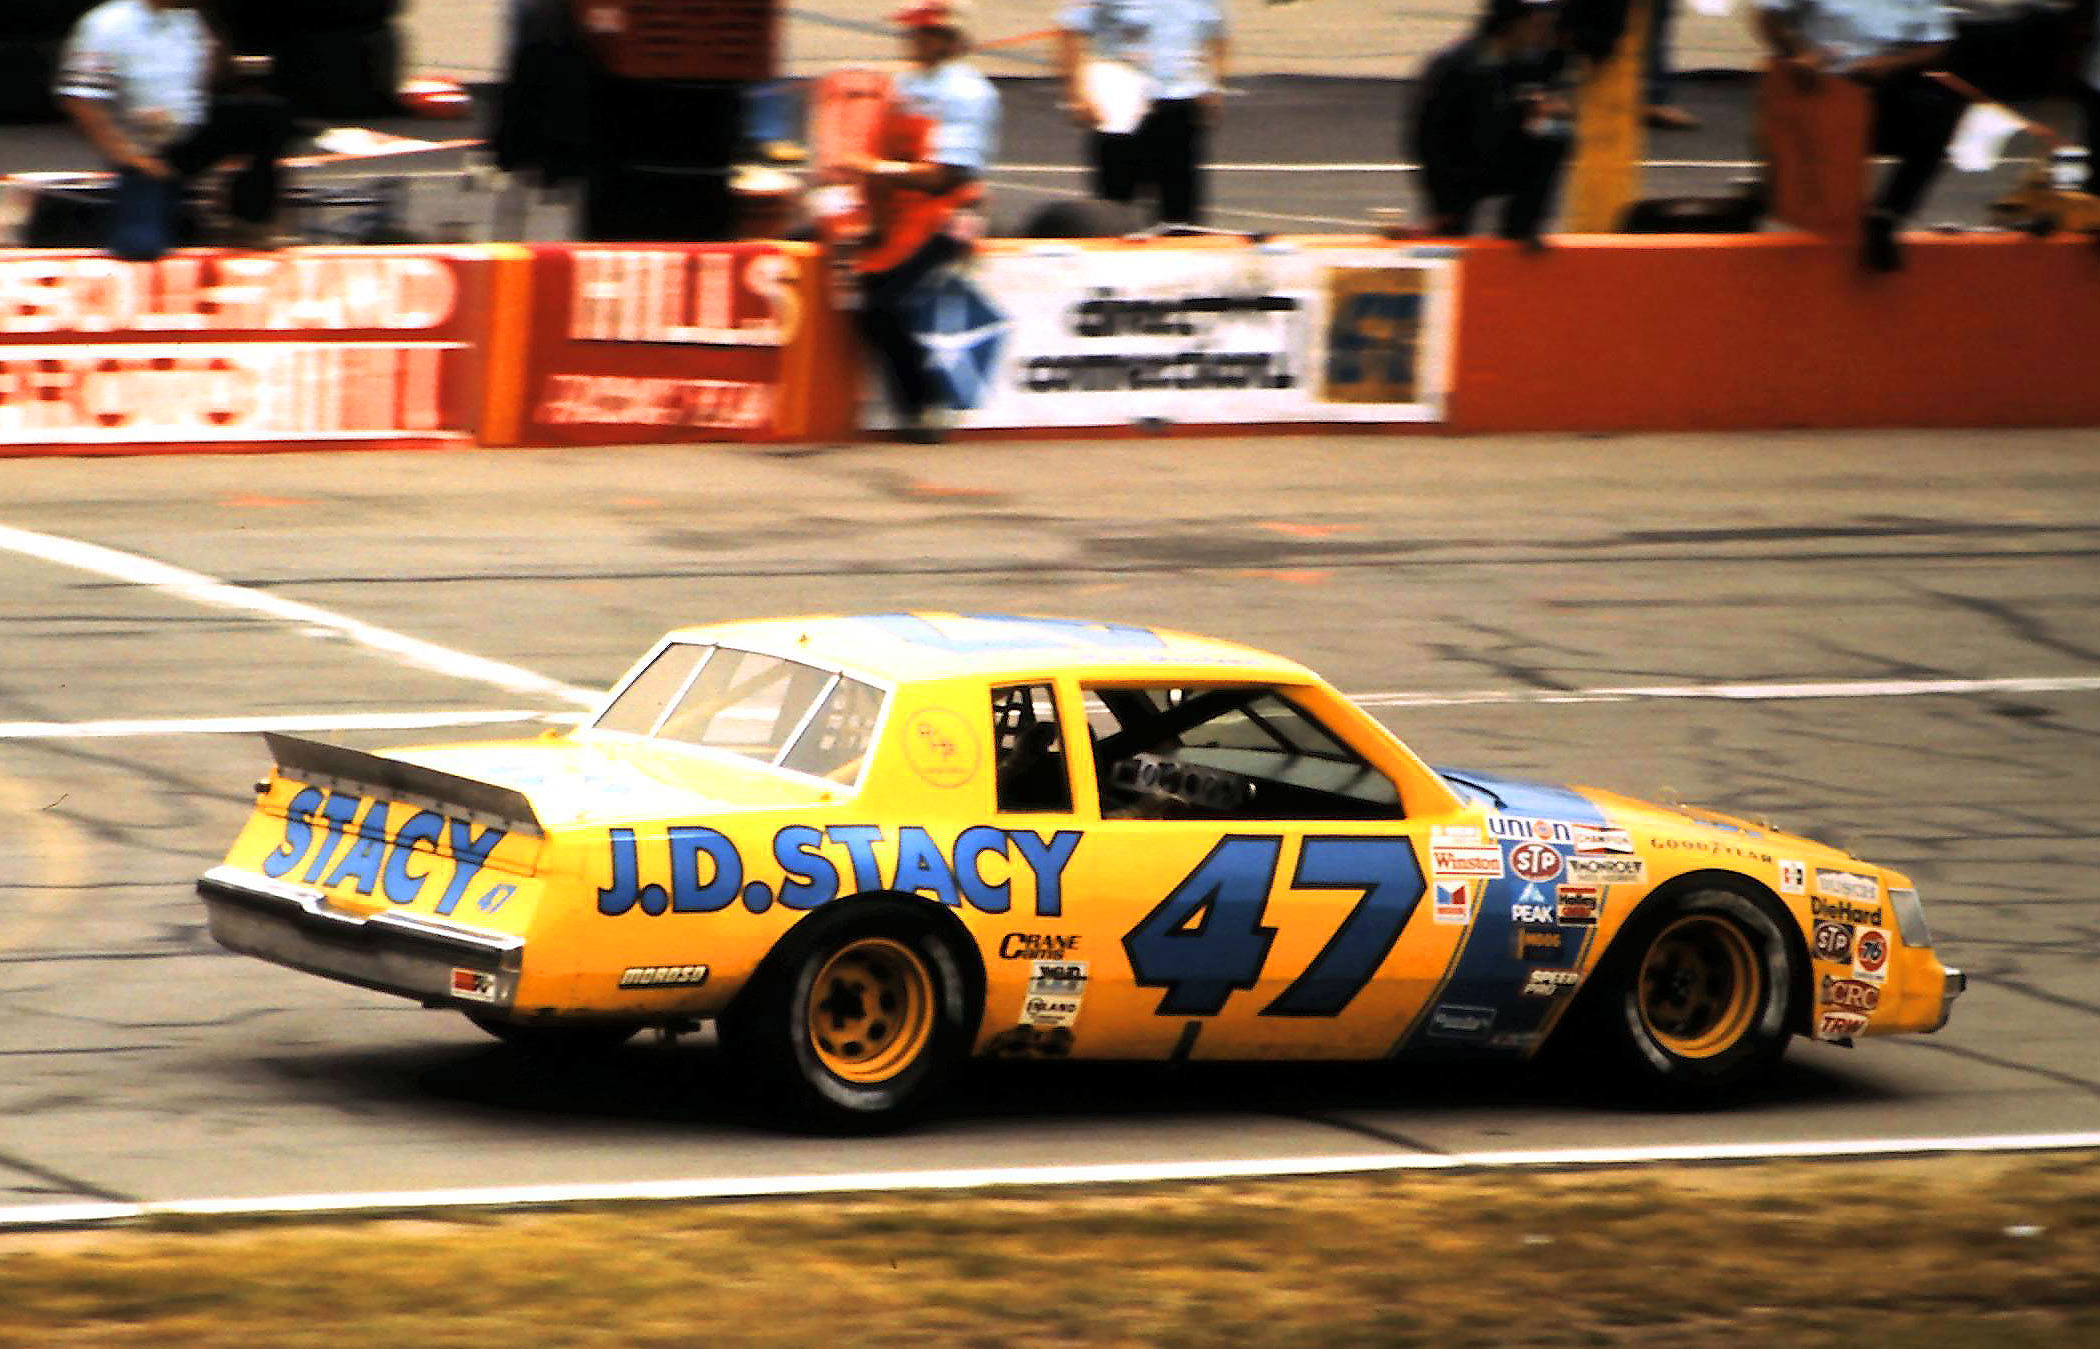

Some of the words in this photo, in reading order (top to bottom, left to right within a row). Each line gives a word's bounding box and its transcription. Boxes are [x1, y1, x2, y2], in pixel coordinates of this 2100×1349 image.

[569, 250, 802, 347] HILLS
[263, 786, 507, 916] STACY
[1433, 851, 1501, 870] Winston
[1516, 845, 1557, 874] STP
[1121, 833, 1428, 1017] 47
[1511, 904, 1553, 923] PEAK
[1811, 896, 1882, 925] DieHard
[1817, 926, 1848, 953] STP
[1860, 941, 1882, 960] 76
